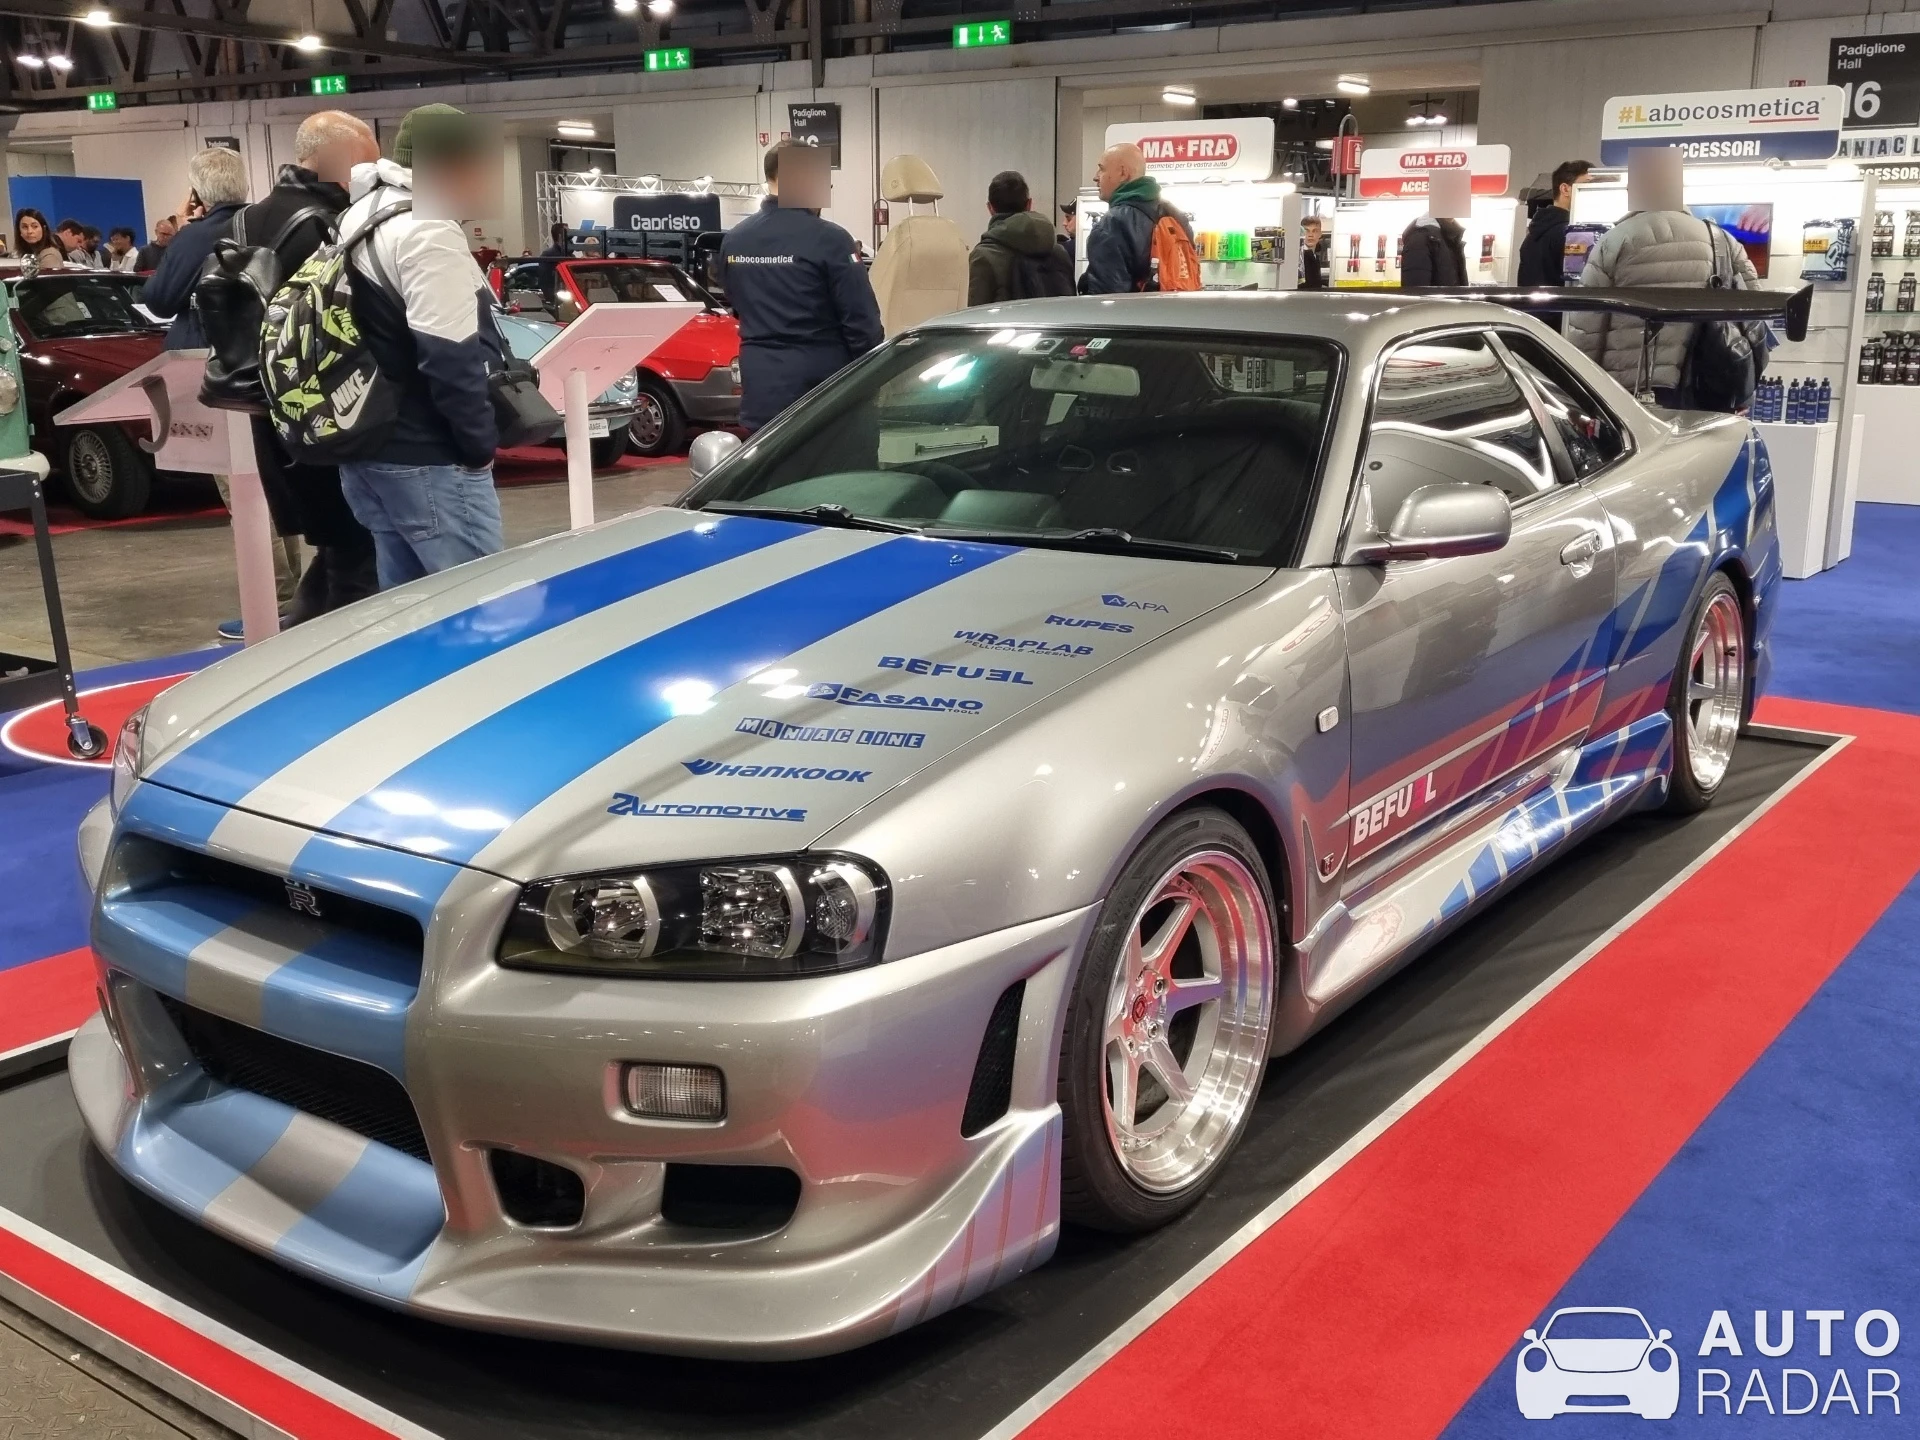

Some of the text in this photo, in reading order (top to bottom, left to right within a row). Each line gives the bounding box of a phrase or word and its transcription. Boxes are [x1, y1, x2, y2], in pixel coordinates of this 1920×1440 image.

[1838, 43, 1906, 57] Padiglione
[1837, 58, 1862, 69] Hall
[1842, 81, 1881, 118] 16
[792, 109, 827, 118] Padiglione
[1618, 98, 1820, 123] #Labocosmetica
[1669, 140, 1761, 159] CCESSORI
[1838, 137, 1905, 156] ANIAC
[1400, 181, 1429, 193] ACCE
[631, 213, 700, 231] Capristo
[330, 368, 365, 414] NIKE
[1126, 601, 1169, 614] APA
[1044, 614, 1135, 634] RUPES
[953, 630, 1094, 656] WRAPLAB
[964, 639, 1024, 653] PELLICOLE
[839, 687, 984, 711] FASANO
[735, 717, 926, 748] MANIAC LINE
